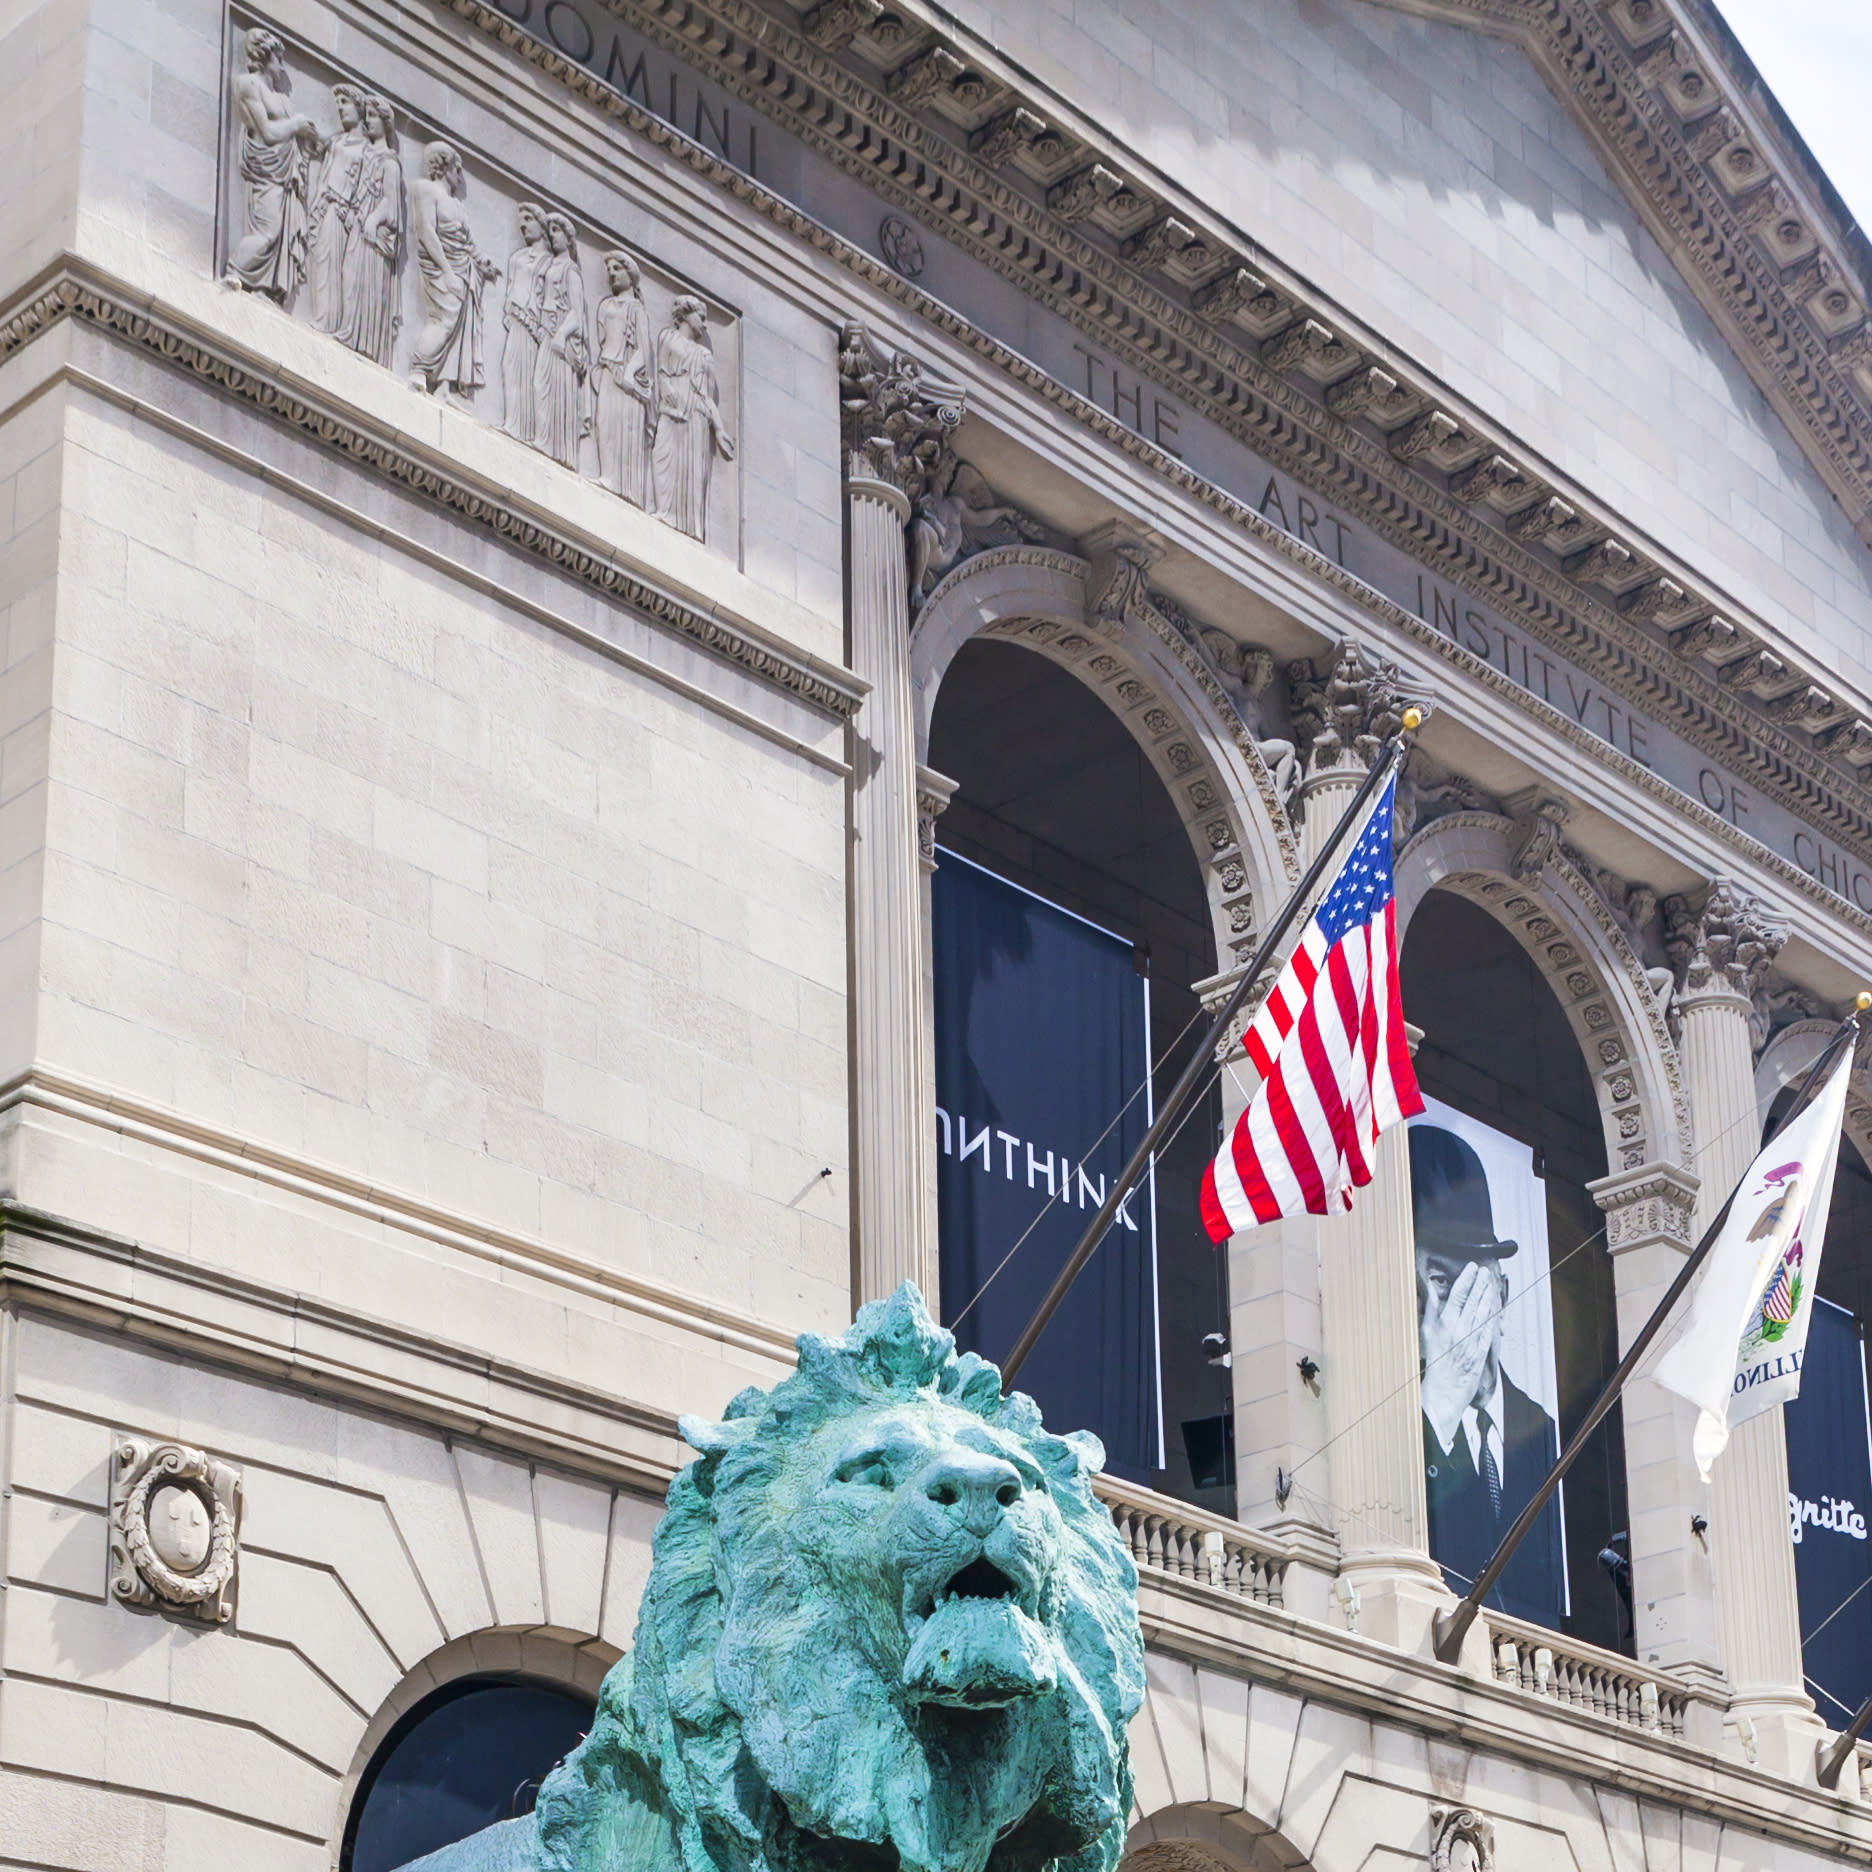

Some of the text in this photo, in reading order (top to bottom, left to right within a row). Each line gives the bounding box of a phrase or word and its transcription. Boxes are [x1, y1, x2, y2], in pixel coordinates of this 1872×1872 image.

[1074, 344, 1184, 459] THE
[1258, 476, 1354, 566] ART
[1698, 768, 1749, 826] OF
